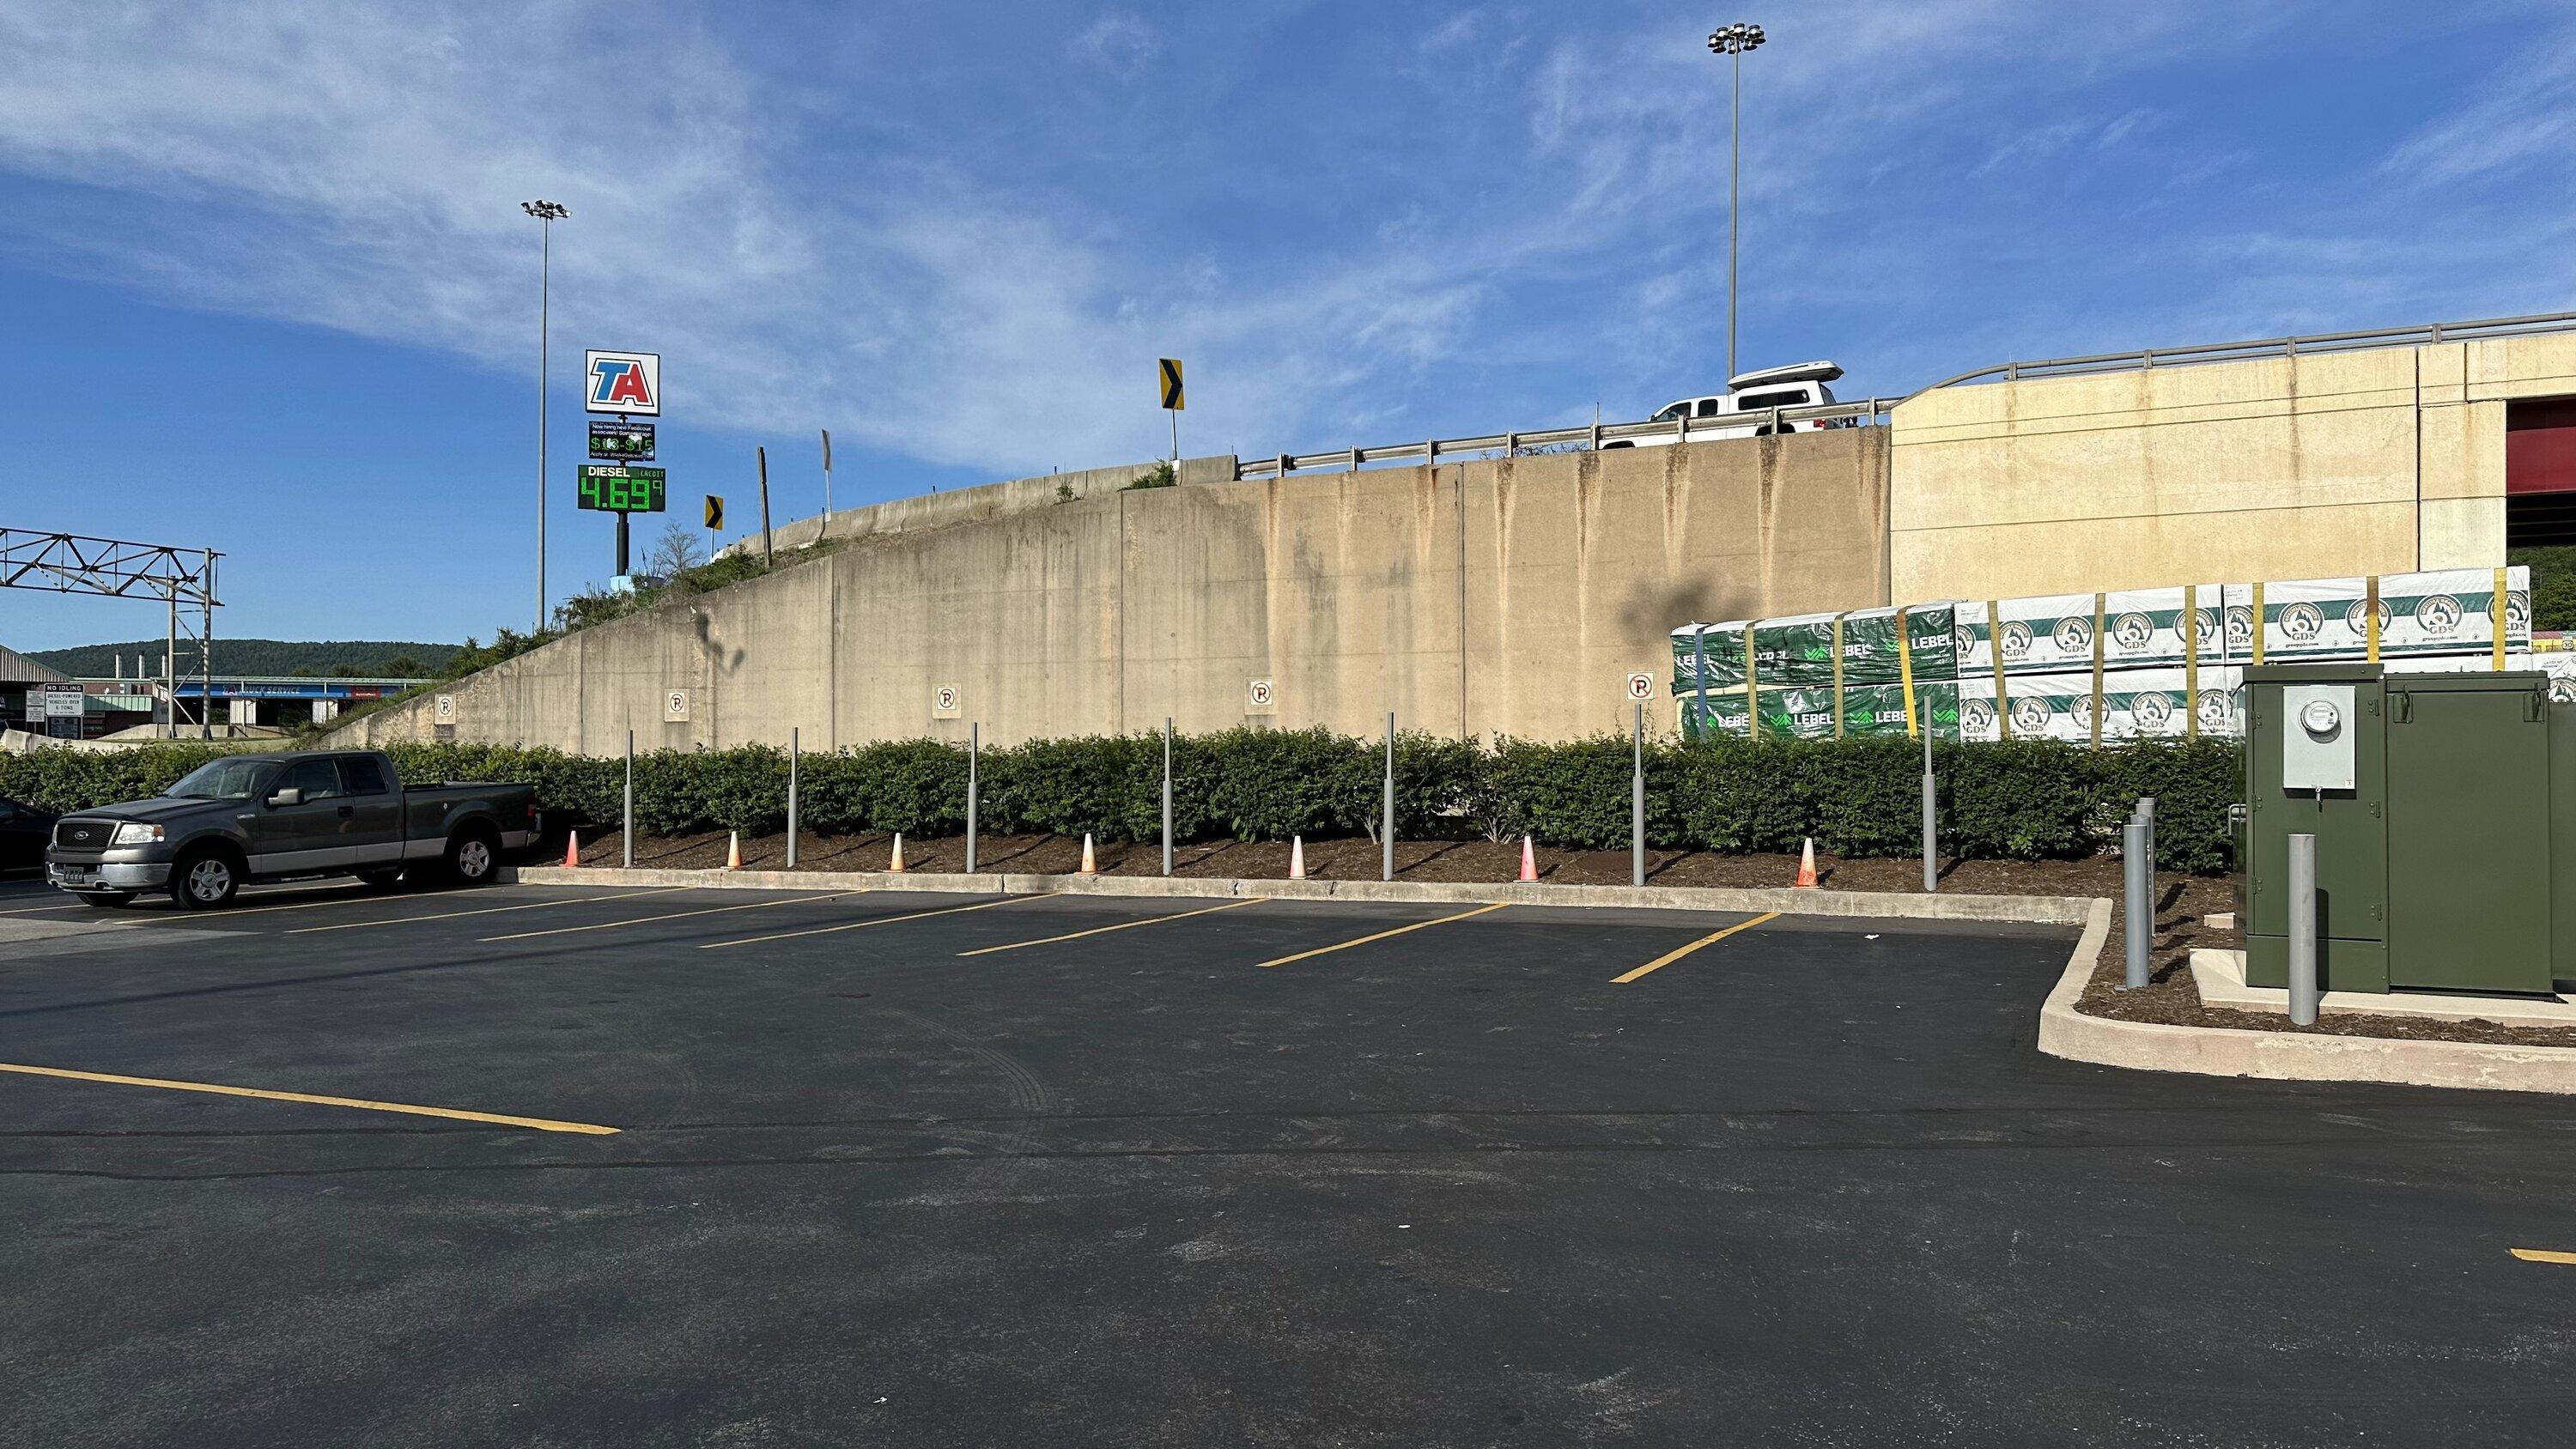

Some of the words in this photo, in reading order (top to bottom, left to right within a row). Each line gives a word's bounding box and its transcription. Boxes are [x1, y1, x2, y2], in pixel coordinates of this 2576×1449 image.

[595, 361, 650, 403] TA
[588, 467, 631, 477] DIESEL
[2429, 625, 2455, 634] GDS
[1912, 634, 1954, 649] LEBEL
[2292, 632, 2316, 641] GDS
[1829, 644, 1869, 658] LBEL
[2065, 644, 2086, 653] GDS
[1719, 715, 1750, 728] LEBE
[1794, 713, 1834, 725] LEBEL
[1875, 710, 1908, 723] LEBE
[2205, 718, 2225, 726] GDS
[2143, 720, 2165, 728] GDS
